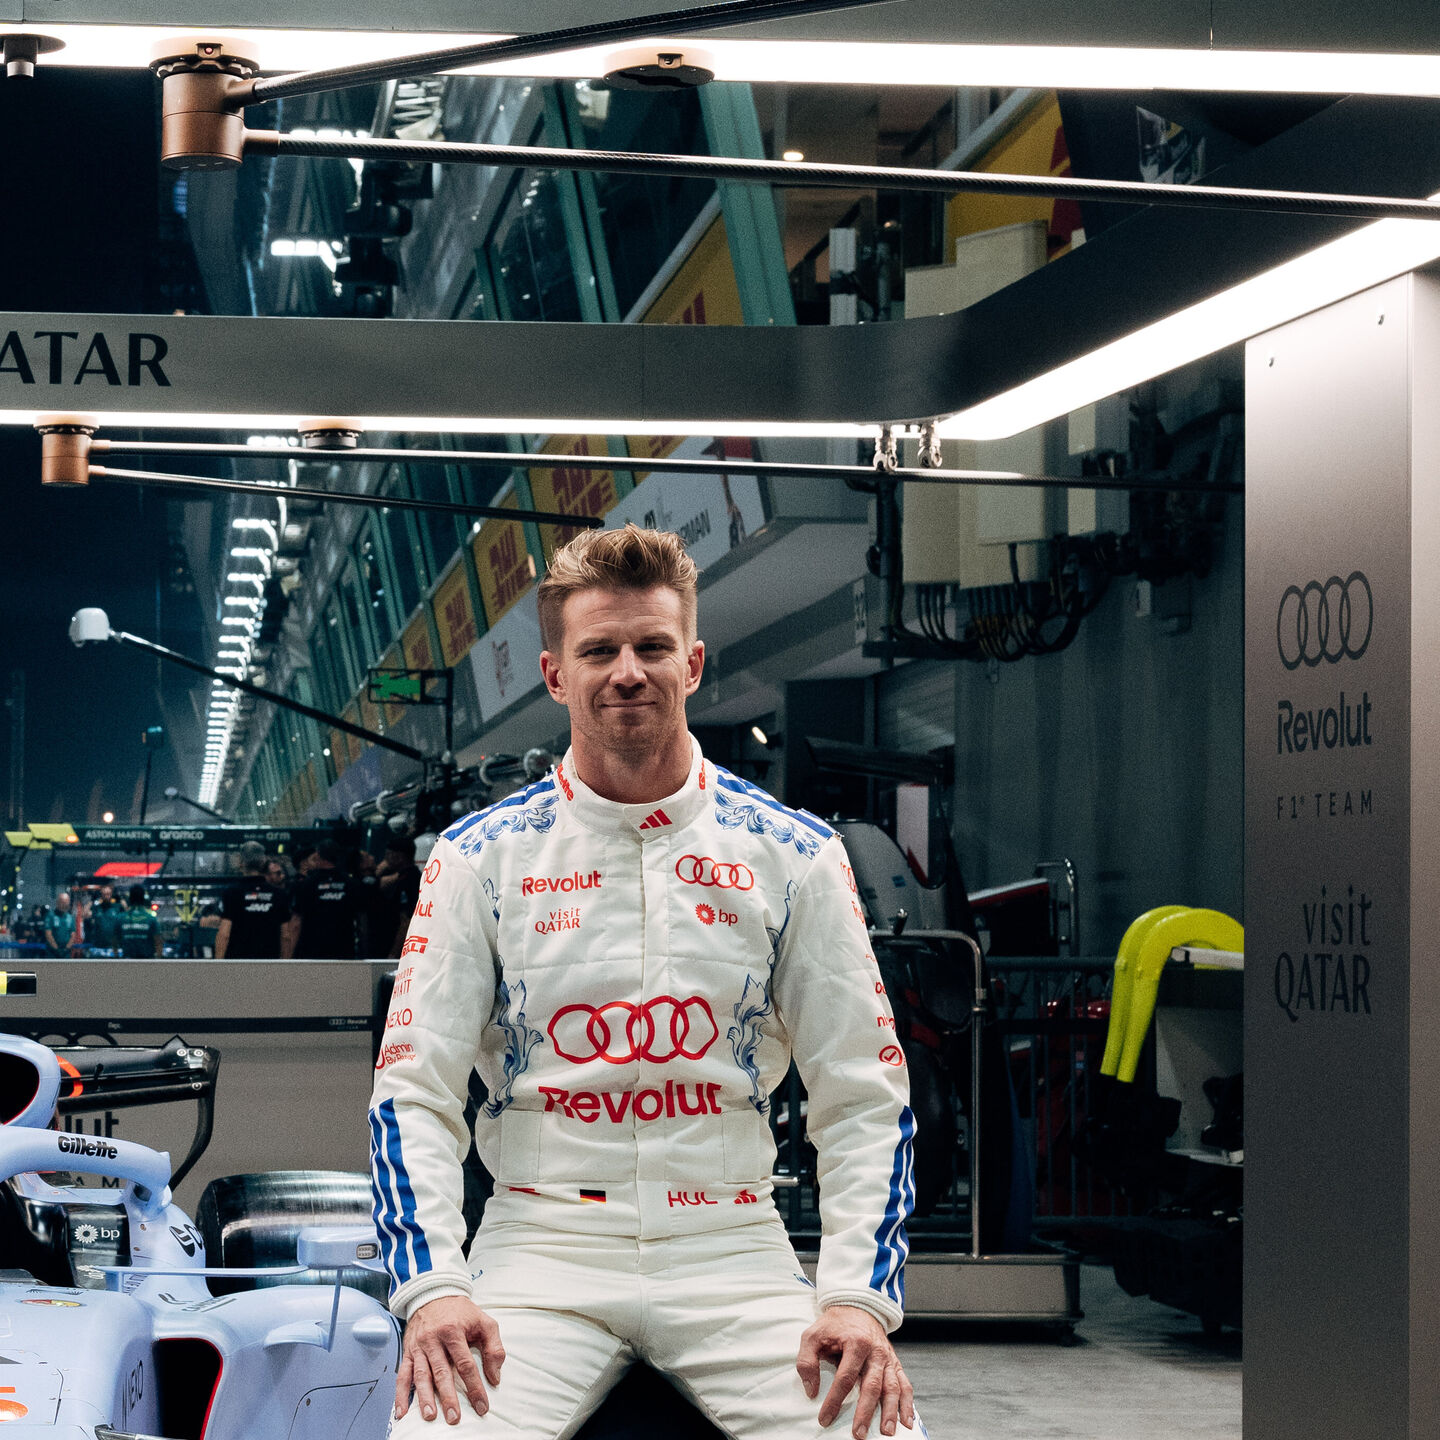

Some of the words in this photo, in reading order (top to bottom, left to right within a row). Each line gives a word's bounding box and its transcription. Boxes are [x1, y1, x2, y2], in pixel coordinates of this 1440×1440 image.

[1278, 691, 1372, 754] Revolut
[1315, 789, 1372, 817] TEAM
[522, 870, 602, 896] Revolut
[549, 906, 581, 921] visit
[718, 908, 738, 927] bp
[1303, 884, 1372, 946] visit
[535, 918, 581, 935] QATAR
[1275, 952, 1372, 1023] QATAR
[538, 1079, 722, 1124] Revolut
[58, 1136, 118, 1160] Gillette
[668, 1191, 718, 1207] HUL
[101, 1227, 120, 1241] bp
